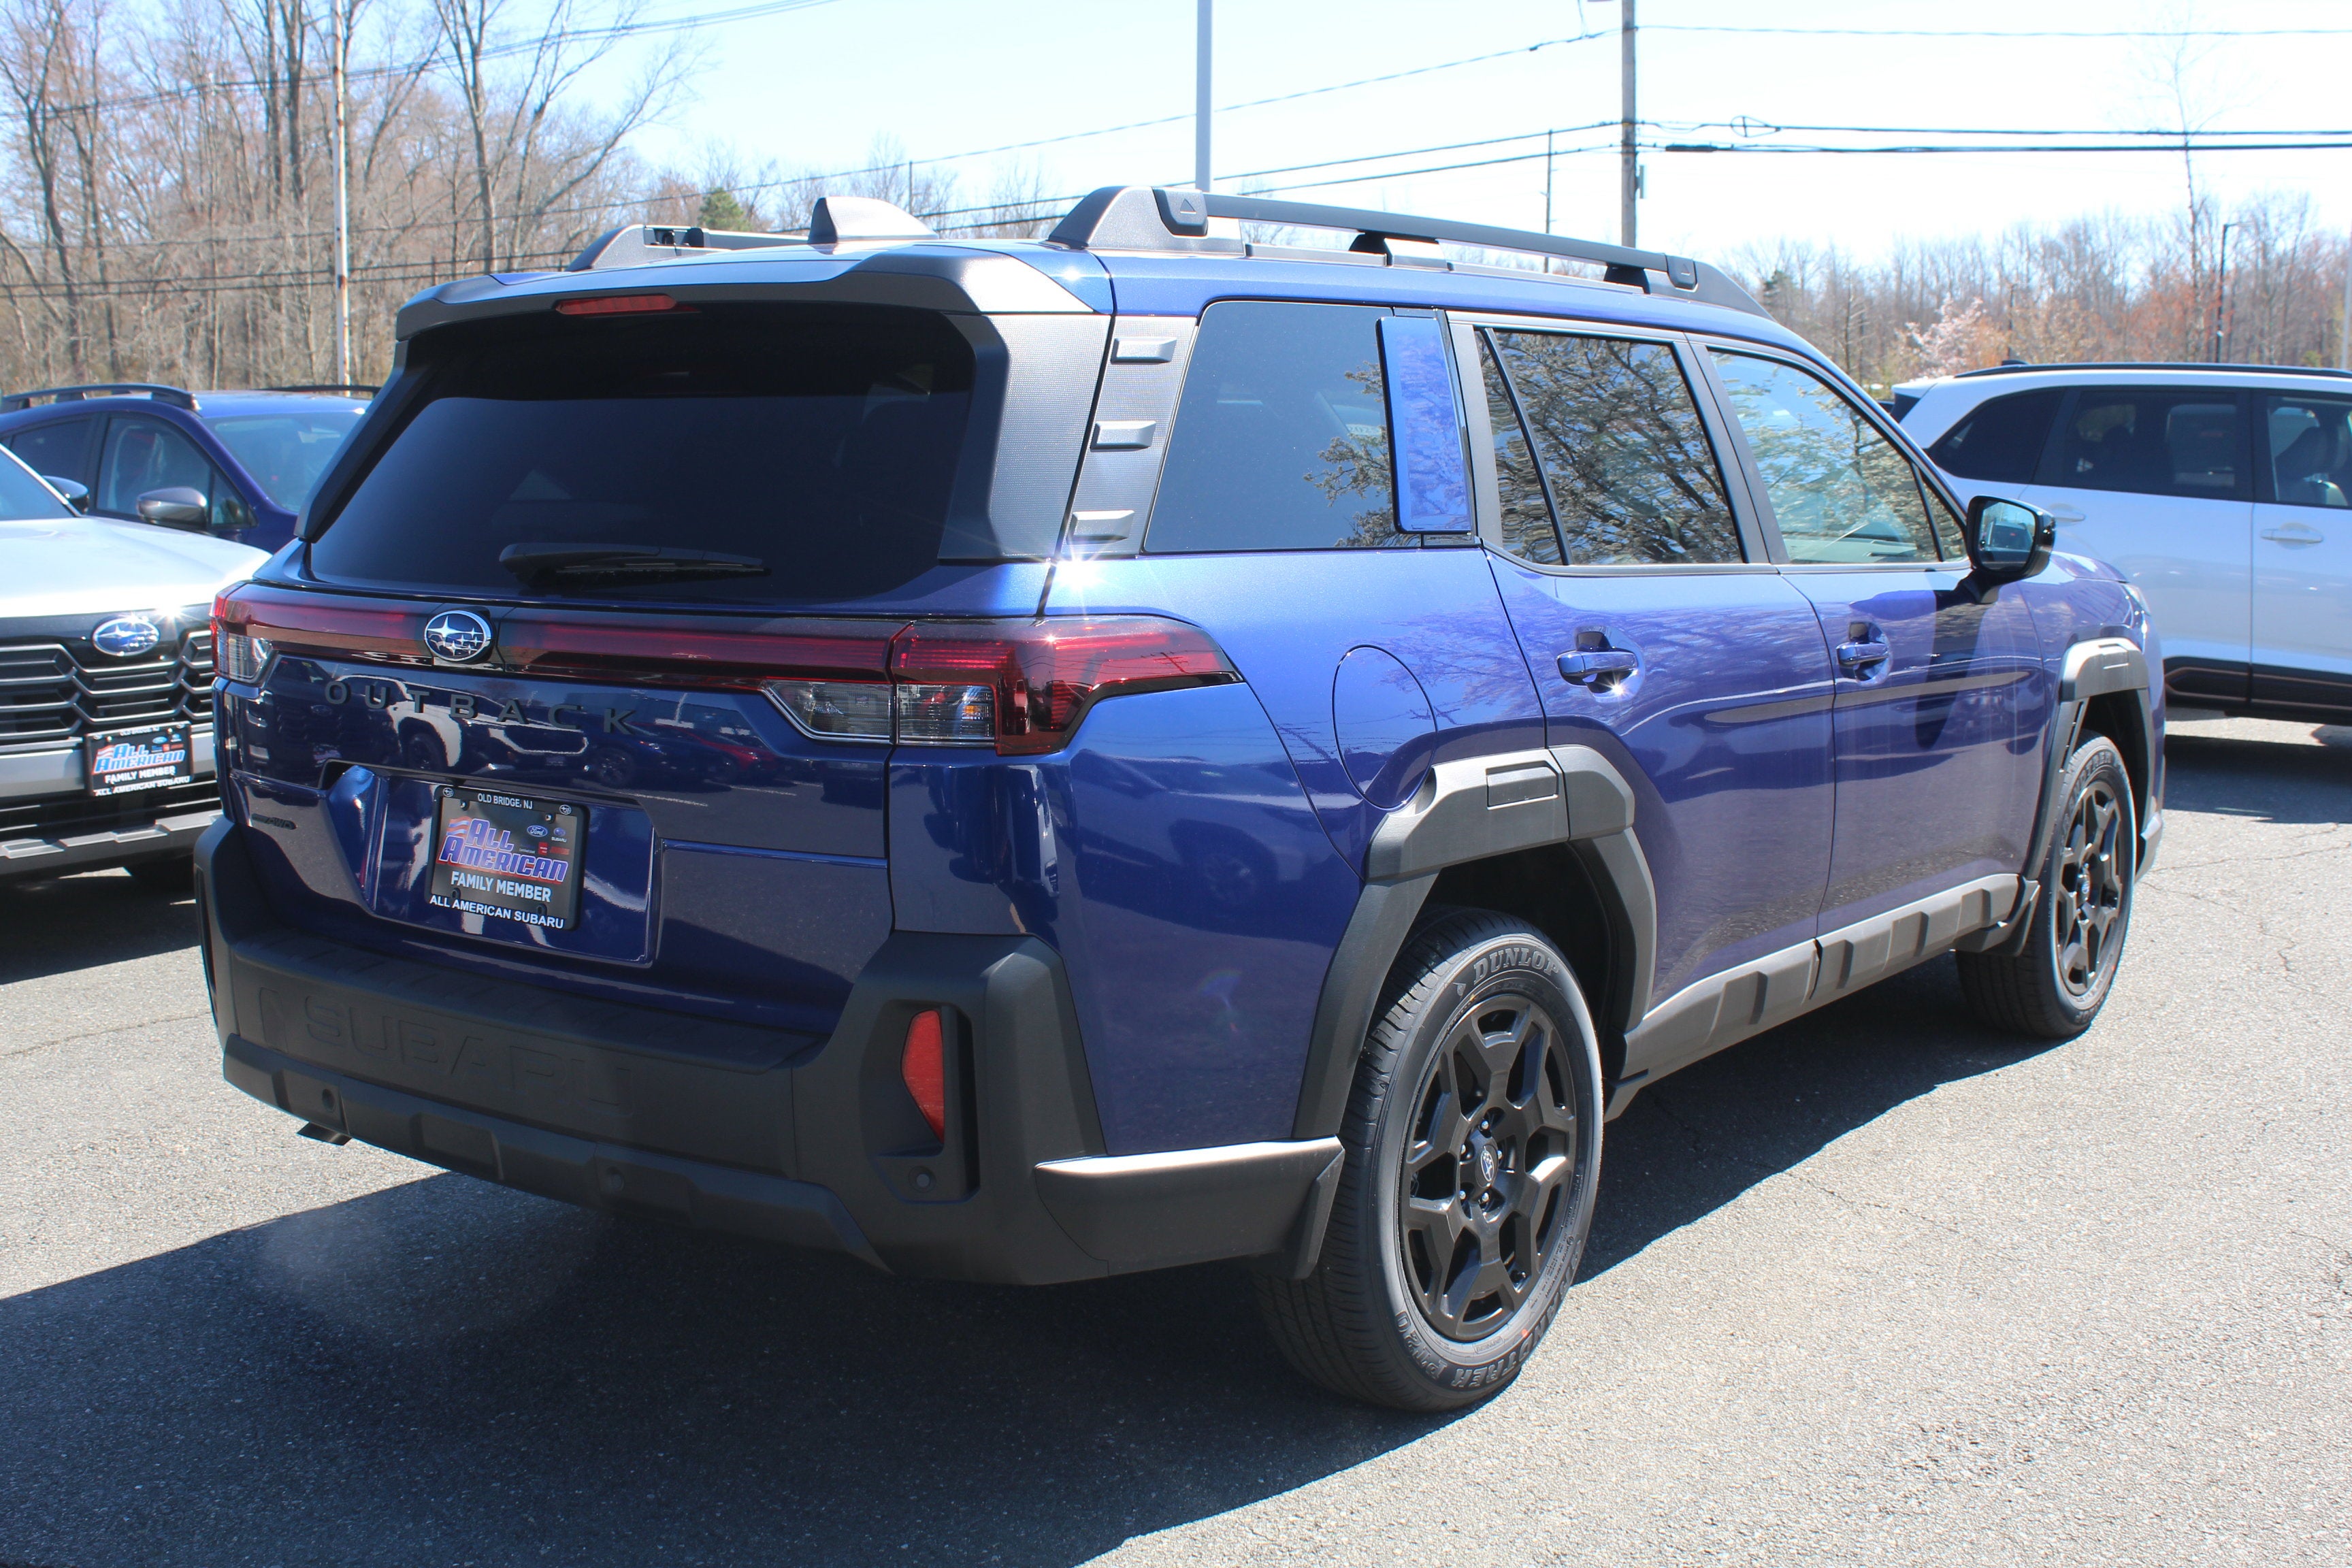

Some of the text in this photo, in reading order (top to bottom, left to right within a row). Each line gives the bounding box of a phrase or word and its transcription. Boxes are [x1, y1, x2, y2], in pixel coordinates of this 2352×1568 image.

[325, 681, 636, 736] OUTBACK
[94, 750, 185, 772] AMERICAN
[114, 743, 150, 759] ALL
[105, 766, 176, 785] FAMILY MEMBER
[113, 782, 156, 794] AMERICAN
[157, 776, 191, 787] SUBARU
[478, 793, 491, 803] OLD
[523, 800, 533, 810] NJ
[466, 818, 514, 852] ALL
[439, 835, 568, 882] AMERICAN
[451, 871, 551, 902] FAMILY MEMBER
[429, 895, 564, 929] ALL AMERICAN SUBARU
[1473, 947, 1559, 985] DUNLOP
[304, 995, 634, 1116] SUBARU
